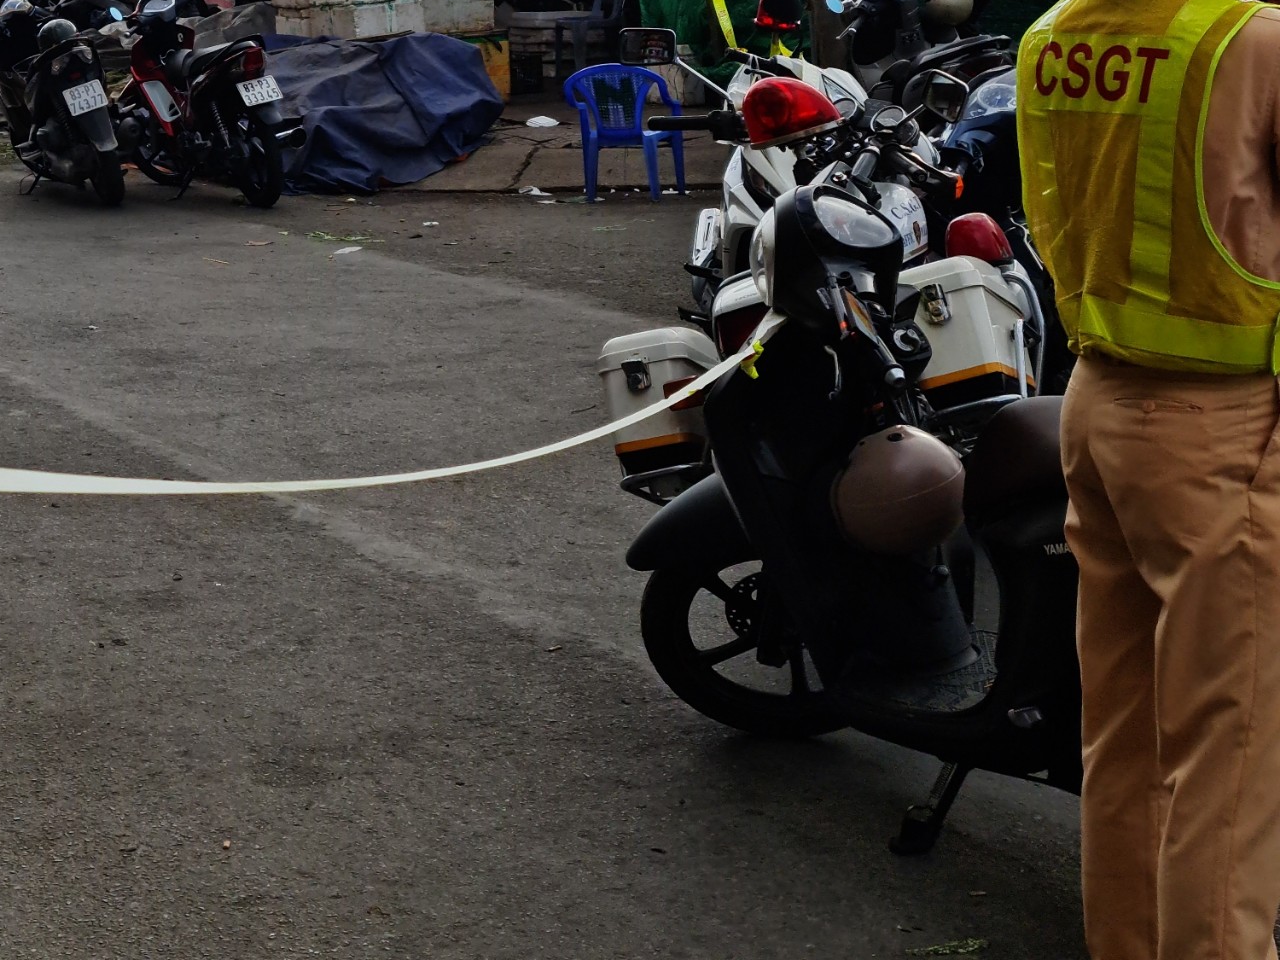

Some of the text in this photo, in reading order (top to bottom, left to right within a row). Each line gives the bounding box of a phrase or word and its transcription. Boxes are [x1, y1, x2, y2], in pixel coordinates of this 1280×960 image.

[1035, 41, 1170, 104] CSGT
[69, 82, 97, 101] 83-P1
[242, 79, 271, 93] 83-P3
